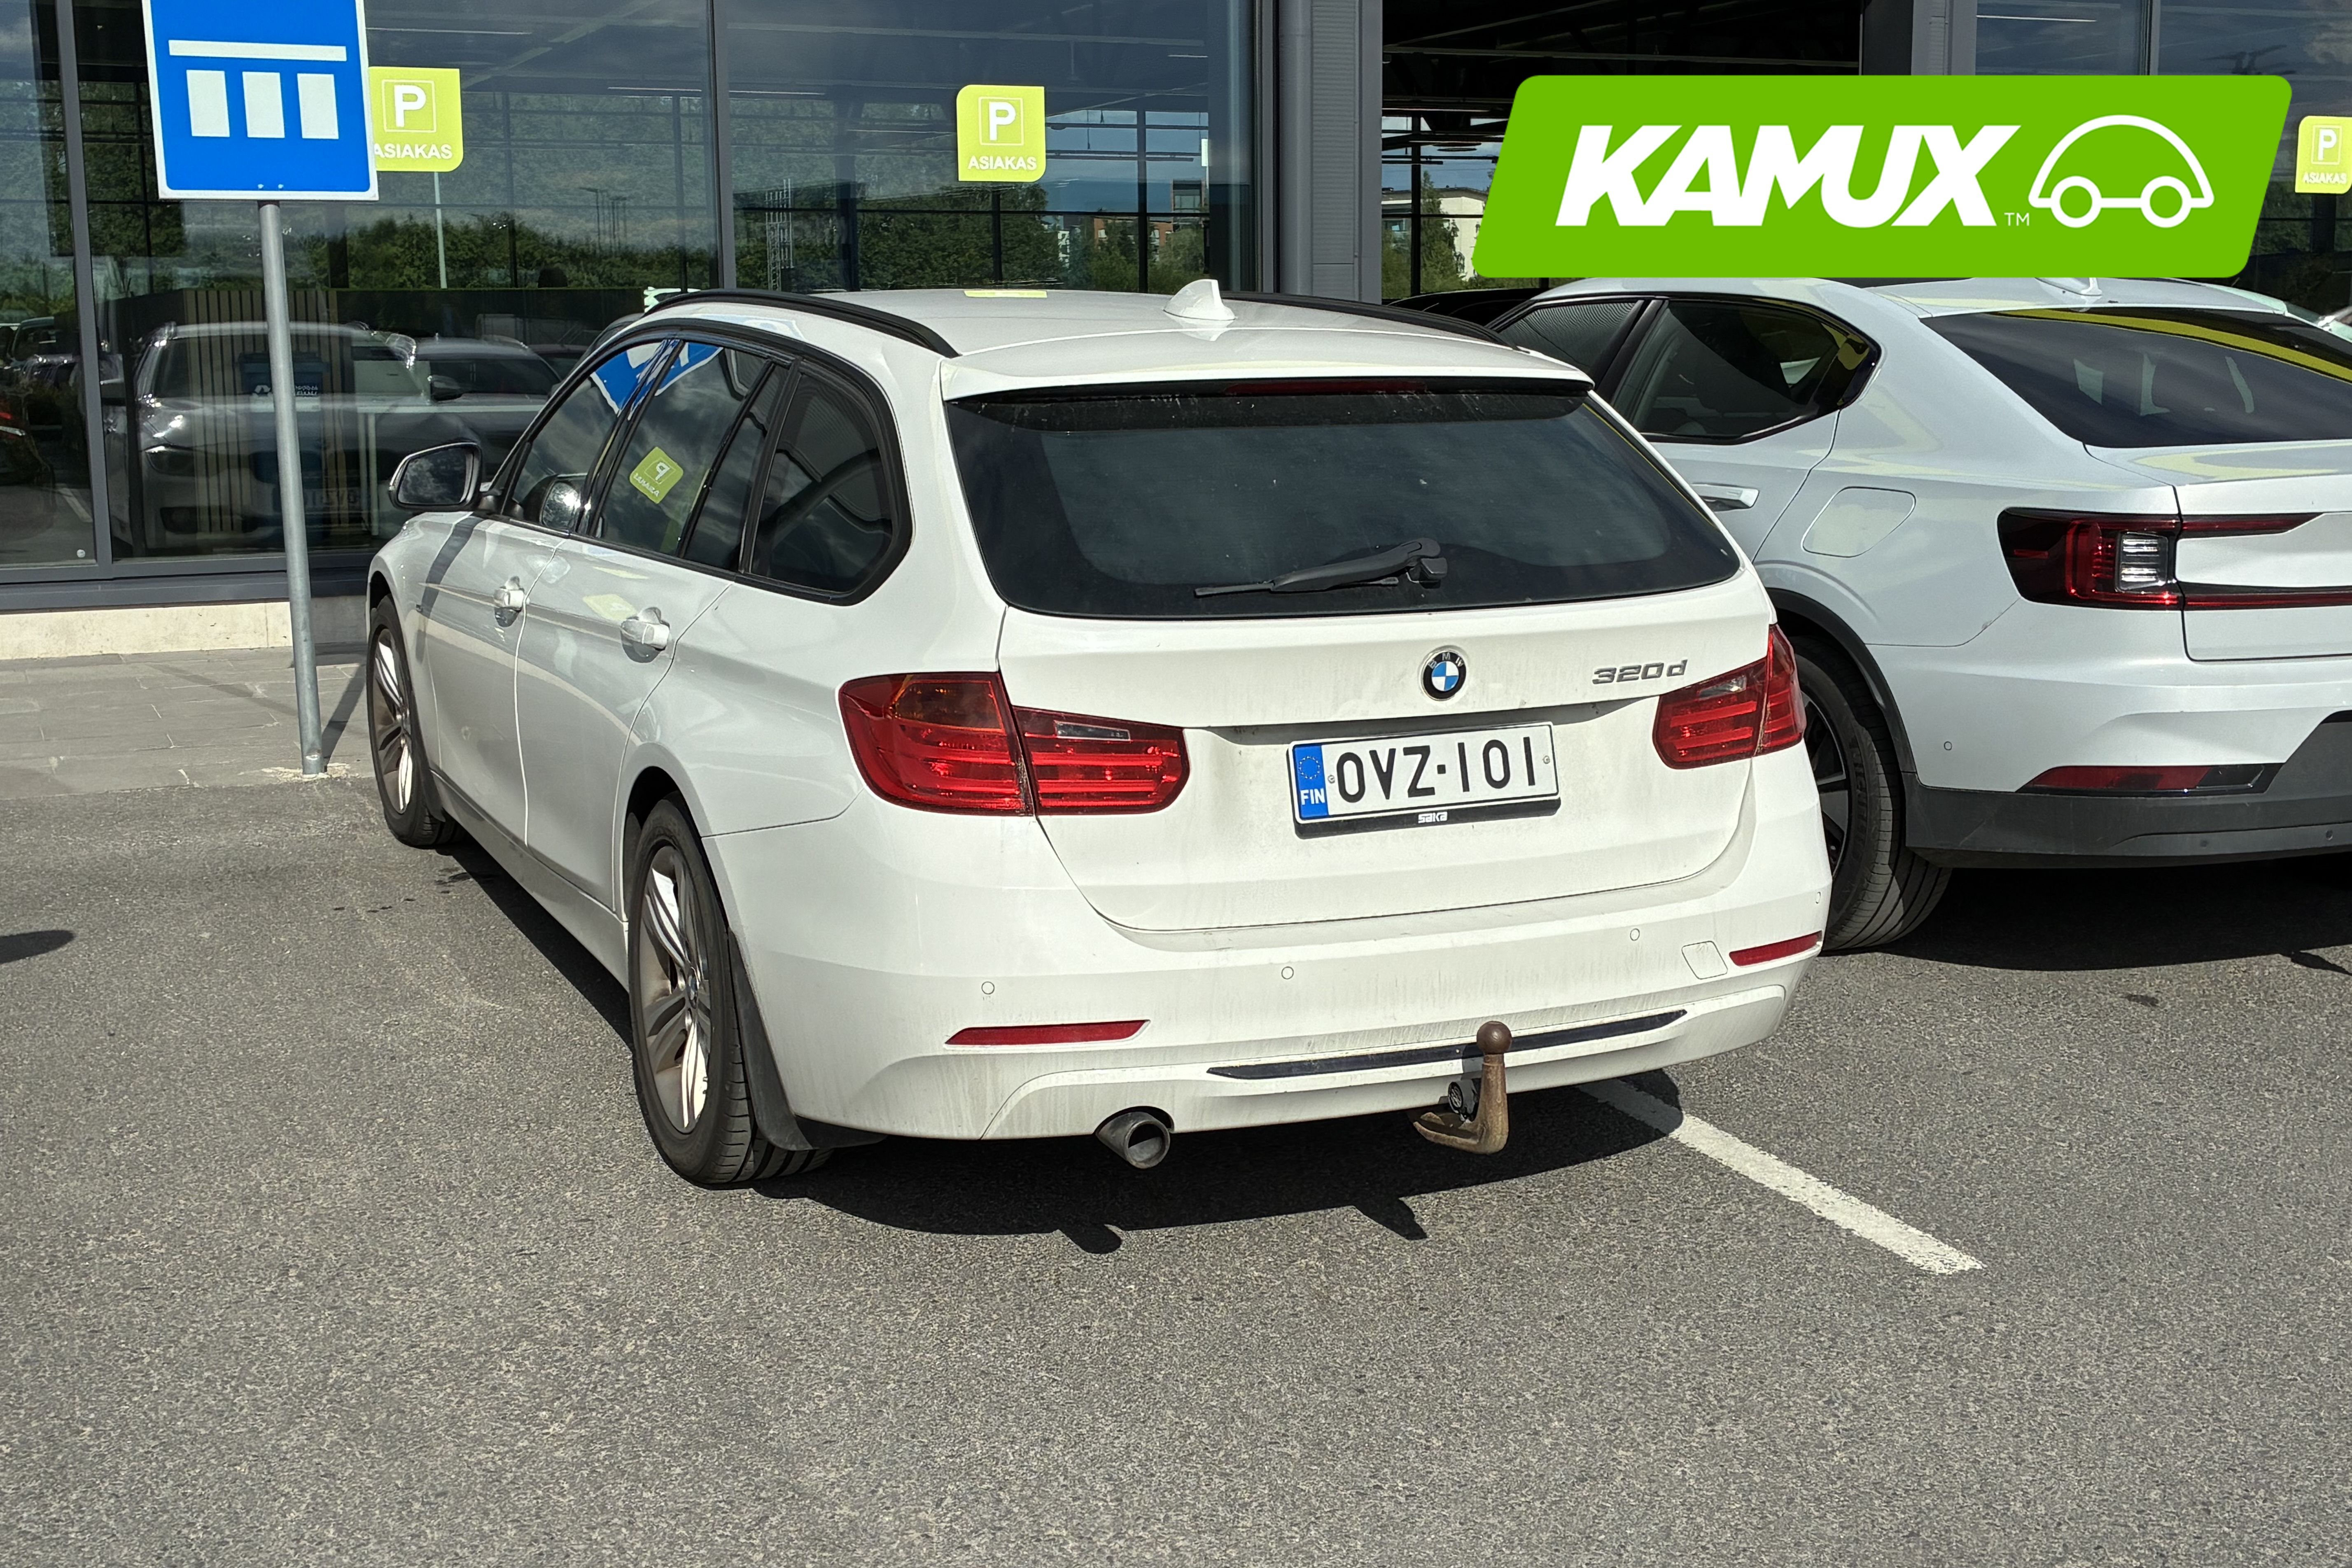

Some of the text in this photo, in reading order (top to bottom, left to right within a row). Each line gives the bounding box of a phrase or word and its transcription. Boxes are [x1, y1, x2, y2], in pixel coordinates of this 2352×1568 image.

[394, 85, 426, 128] P
[989, 101, 1016, 140] P
[374, 143, 453, 159] ASIAKAS
[2318, 129, 2337, 161] P
[968, 155, 1037, 170] ASIAKAS
[2303, 171, 2347, 184] ASIAKAS
[1428, 652, 1465, 669] BMW
[1592, 659, 1688, 684] 320d
[1300, 788, 1325, 805] FIN
